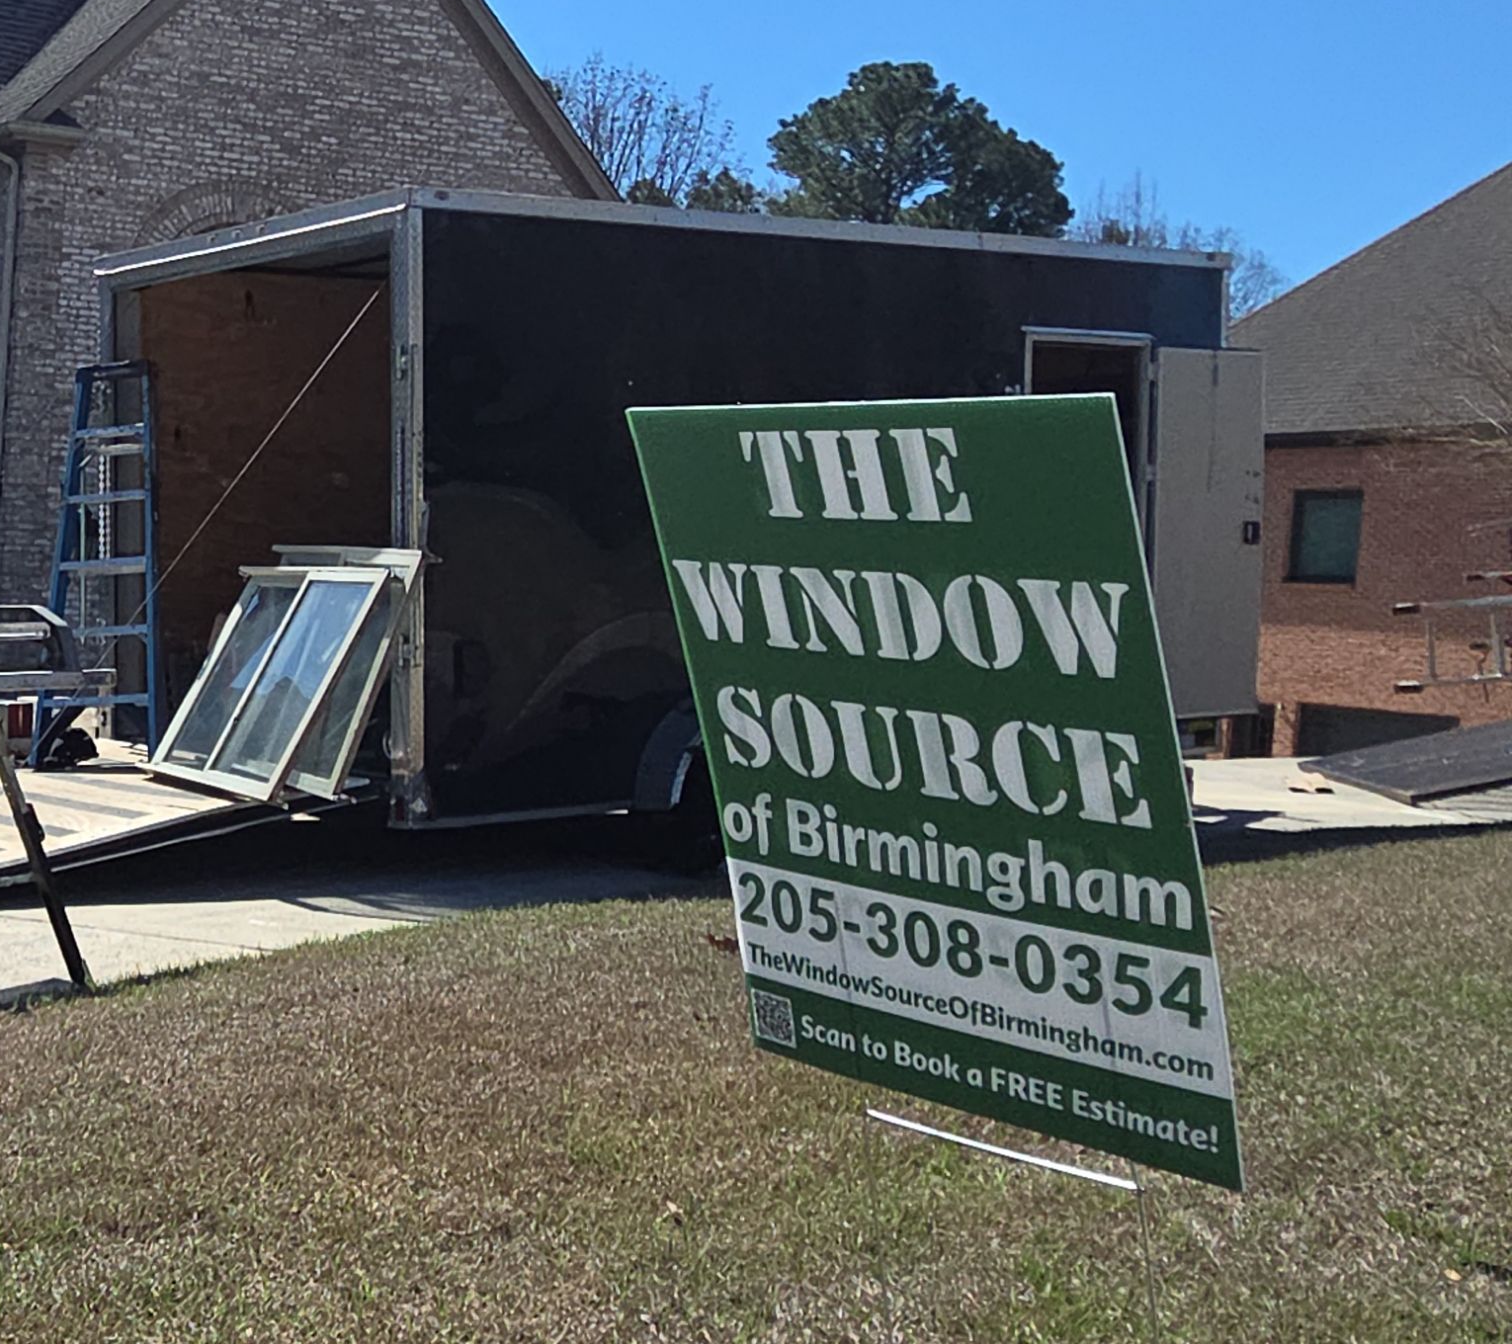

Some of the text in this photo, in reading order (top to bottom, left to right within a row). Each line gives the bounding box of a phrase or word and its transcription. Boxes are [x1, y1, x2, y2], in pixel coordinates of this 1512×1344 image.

[738, 427, 973, 523] THE
[672, 559, 1130, 679] WINDOW
[716, 685, 1153, 830] SOURCE
[723, 793, 1192, 931] of Birmingham
[738, 872, 1209, 1030] 205-308-0354
[747, 942, 1214, 1081] TheWindowSourceOfBirmingham.com
[800, 1015, 1220, 1154] Scan to Book a FREE Estimate!
